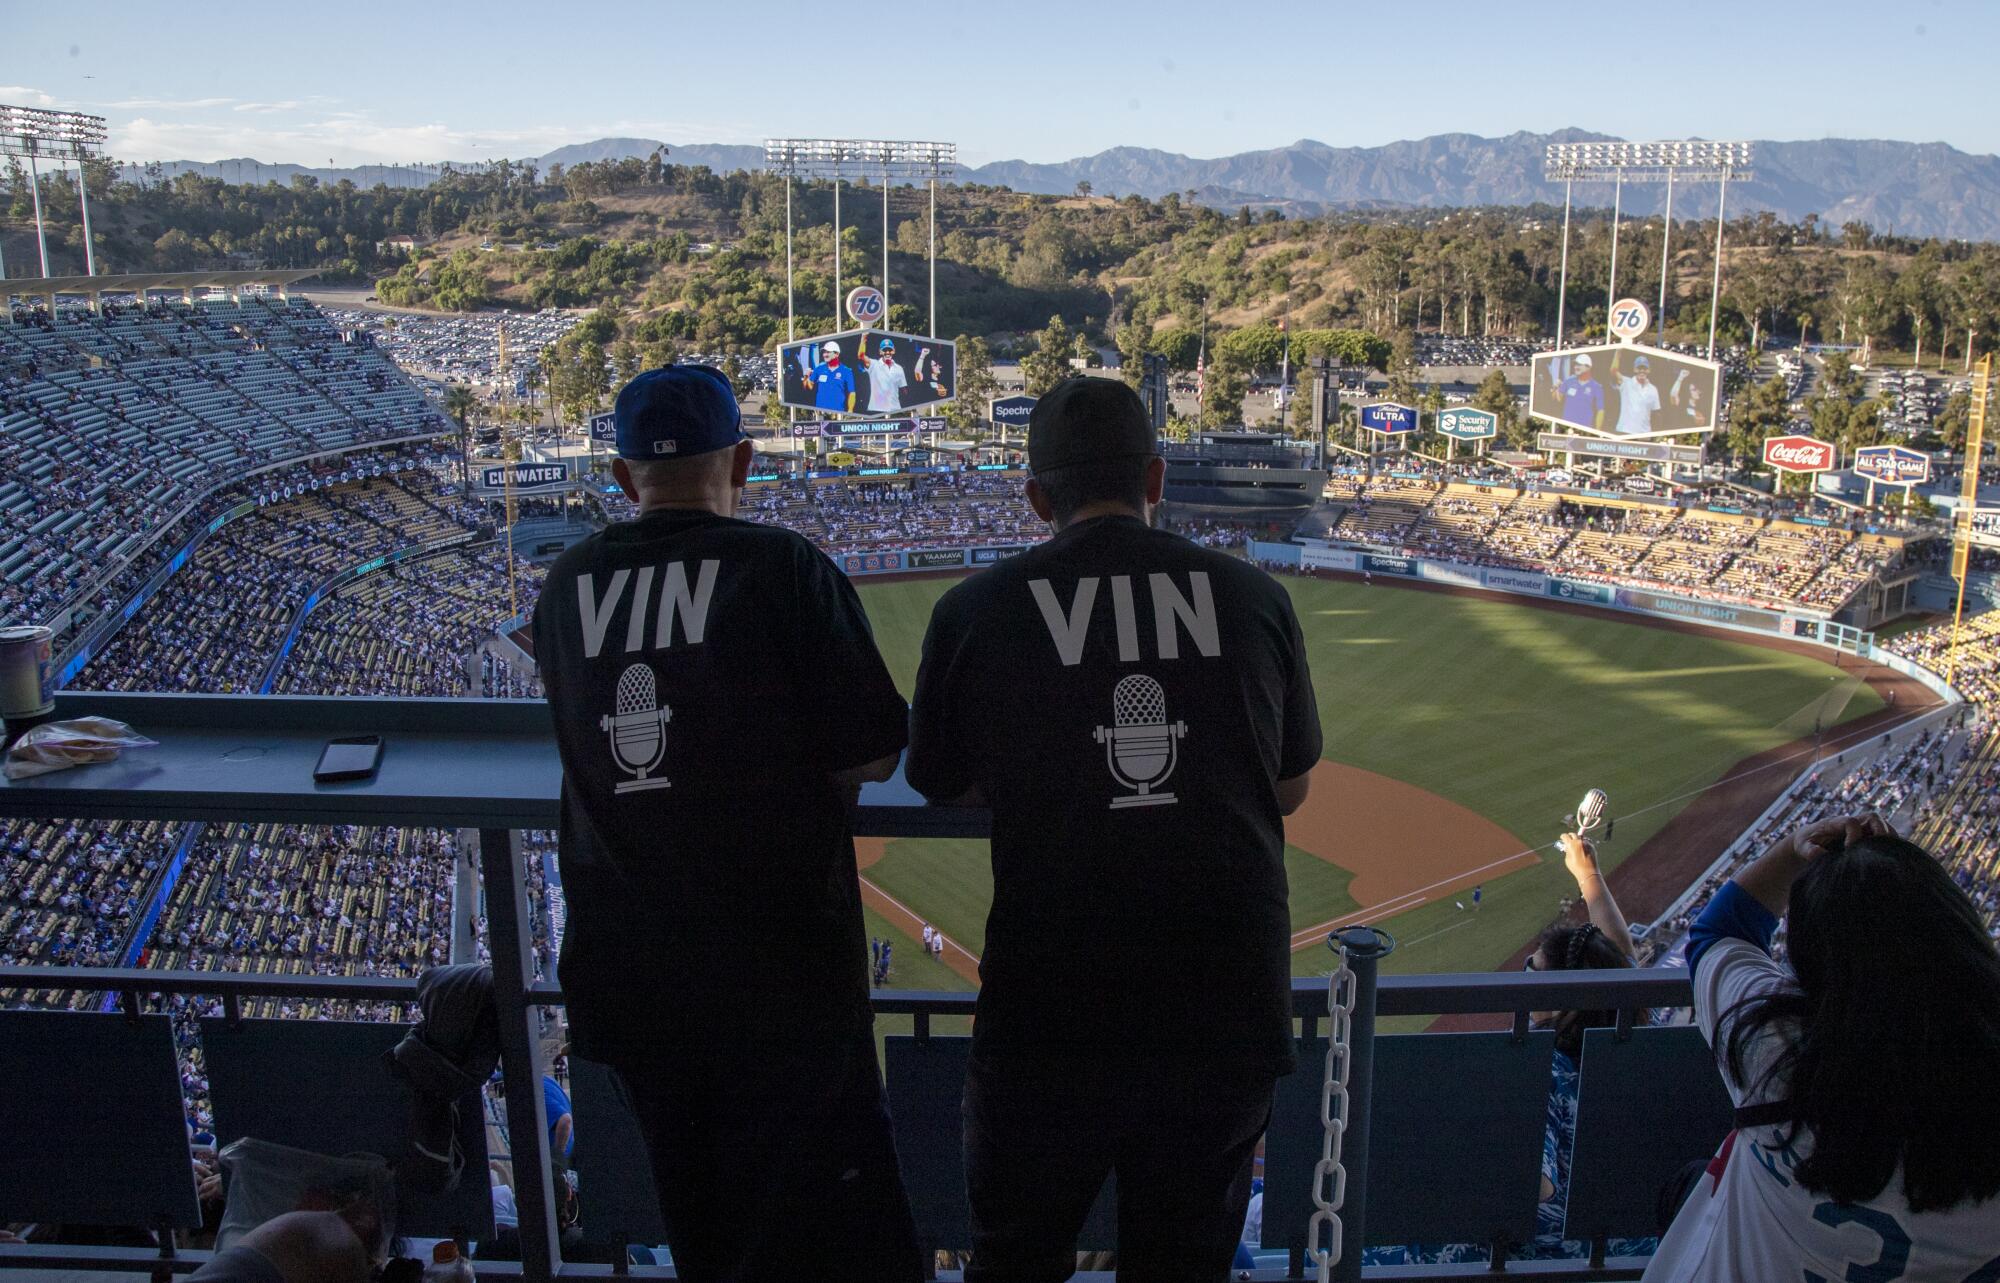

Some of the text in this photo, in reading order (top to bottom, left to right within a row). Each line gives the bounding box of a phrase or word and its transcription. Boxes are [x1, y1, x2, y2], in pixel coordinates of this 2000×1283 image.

[856, 294, 881, 315] 76
[1616, 308, 1641, 328] 76
[1372, 411, 1405, 421] ULTRA
[1458, 415, 1490, 426] Security
[841, 422, 900, 432] UNION NIGHT
[1458, 425, 1485, 433] Benefit
[1586, 442, 1649, 455] UNION NIGHT
[1769, 443, 1826, 466] Coca-Cola
[1858, 457, 1924, 473] ALL STAR GAME
[488, 467, 562, 485] CUTWATER
[978, 551, 995, 559] UCLA
[1371, 557, 1406, 568] Spectrum
[1489, 575, 1543, 590] smartwater
[577, 559, 721, 658] VIN
[1656, 599, 1738, 621] UNION NIGHT
[1028, 571, 1221, 666] VIN
